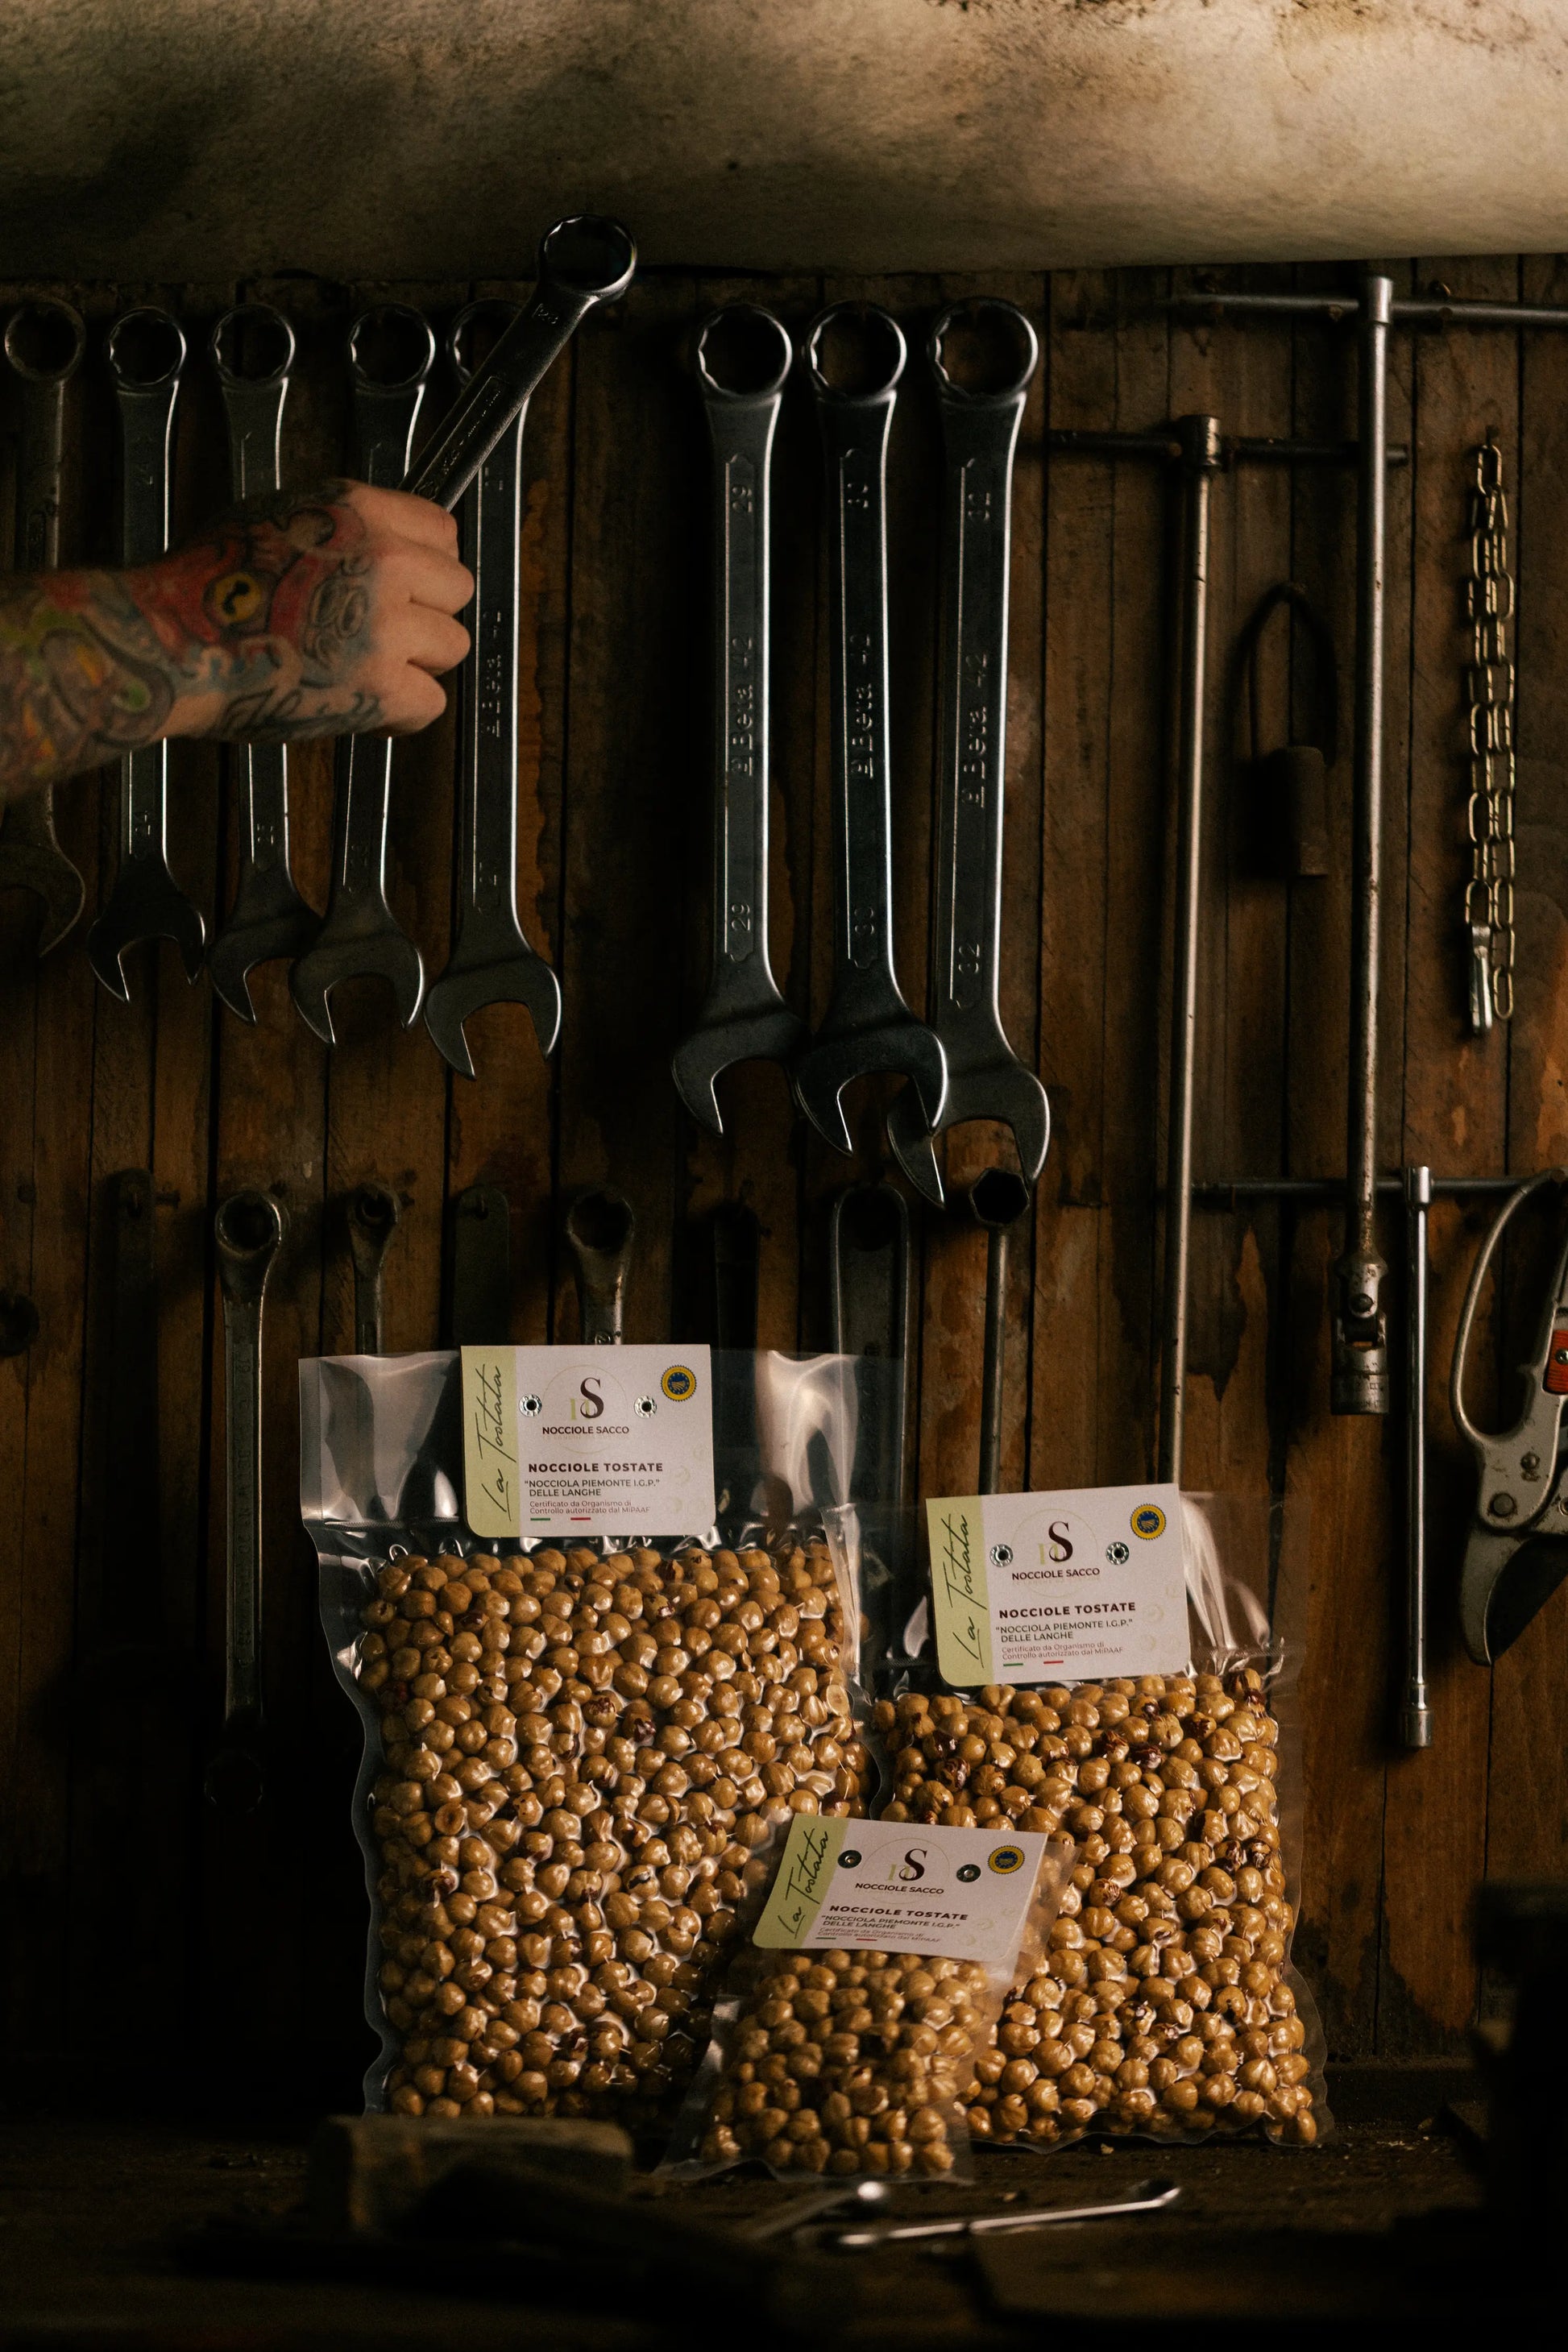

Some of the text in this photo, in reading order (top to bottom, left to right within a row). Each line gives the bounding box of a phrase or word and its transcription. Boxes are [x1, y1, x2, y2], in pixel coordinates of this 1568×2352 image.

[731, 903, 752, 932] 29
[542, 1426, 630, 1434] NOCCIOLE SACCO
[528, 1462, 663, 1473] NOCCIOLE TOSTATE
[582, 1479, 631, 1487] PIEMONTE
[481, 1468, 512, 1522] La
[529, 1488, 601, 1496] DELLE LANGHE
[581, 1500, 623, 1508] Organismo
[1011, 1568, 1101, 1580] NOCCIOLE SACCO
[998, 1602, 1136, 1619] NOCCIOLE TOSTATE
[1053, 1620, 1103, 1631] PIEMONTE
[952, 1616, 985, 1669] La
[1001, 1631, 1074, 1643] DELLE LANGHE
[1002, 1644, 1041, 1653] Certificato
[1043, 1643, 1052, 1651] da
[1054, 1642, 1096, 1651] Organismo
[1002, 1651, 1037, 1661] Controllo
[1038, 1649, 1080, 1658] autorizzato
[855, 1883, 907, 1892] NOCCIOLE
[908, 1886, 944, 1894] SACCO
[829, 1905, 969, 1921] NOCCIOLE TOSTATE
[778, 1906, 806, 1939] La
[878, 1918, 929, 1927] PIEMONTE
